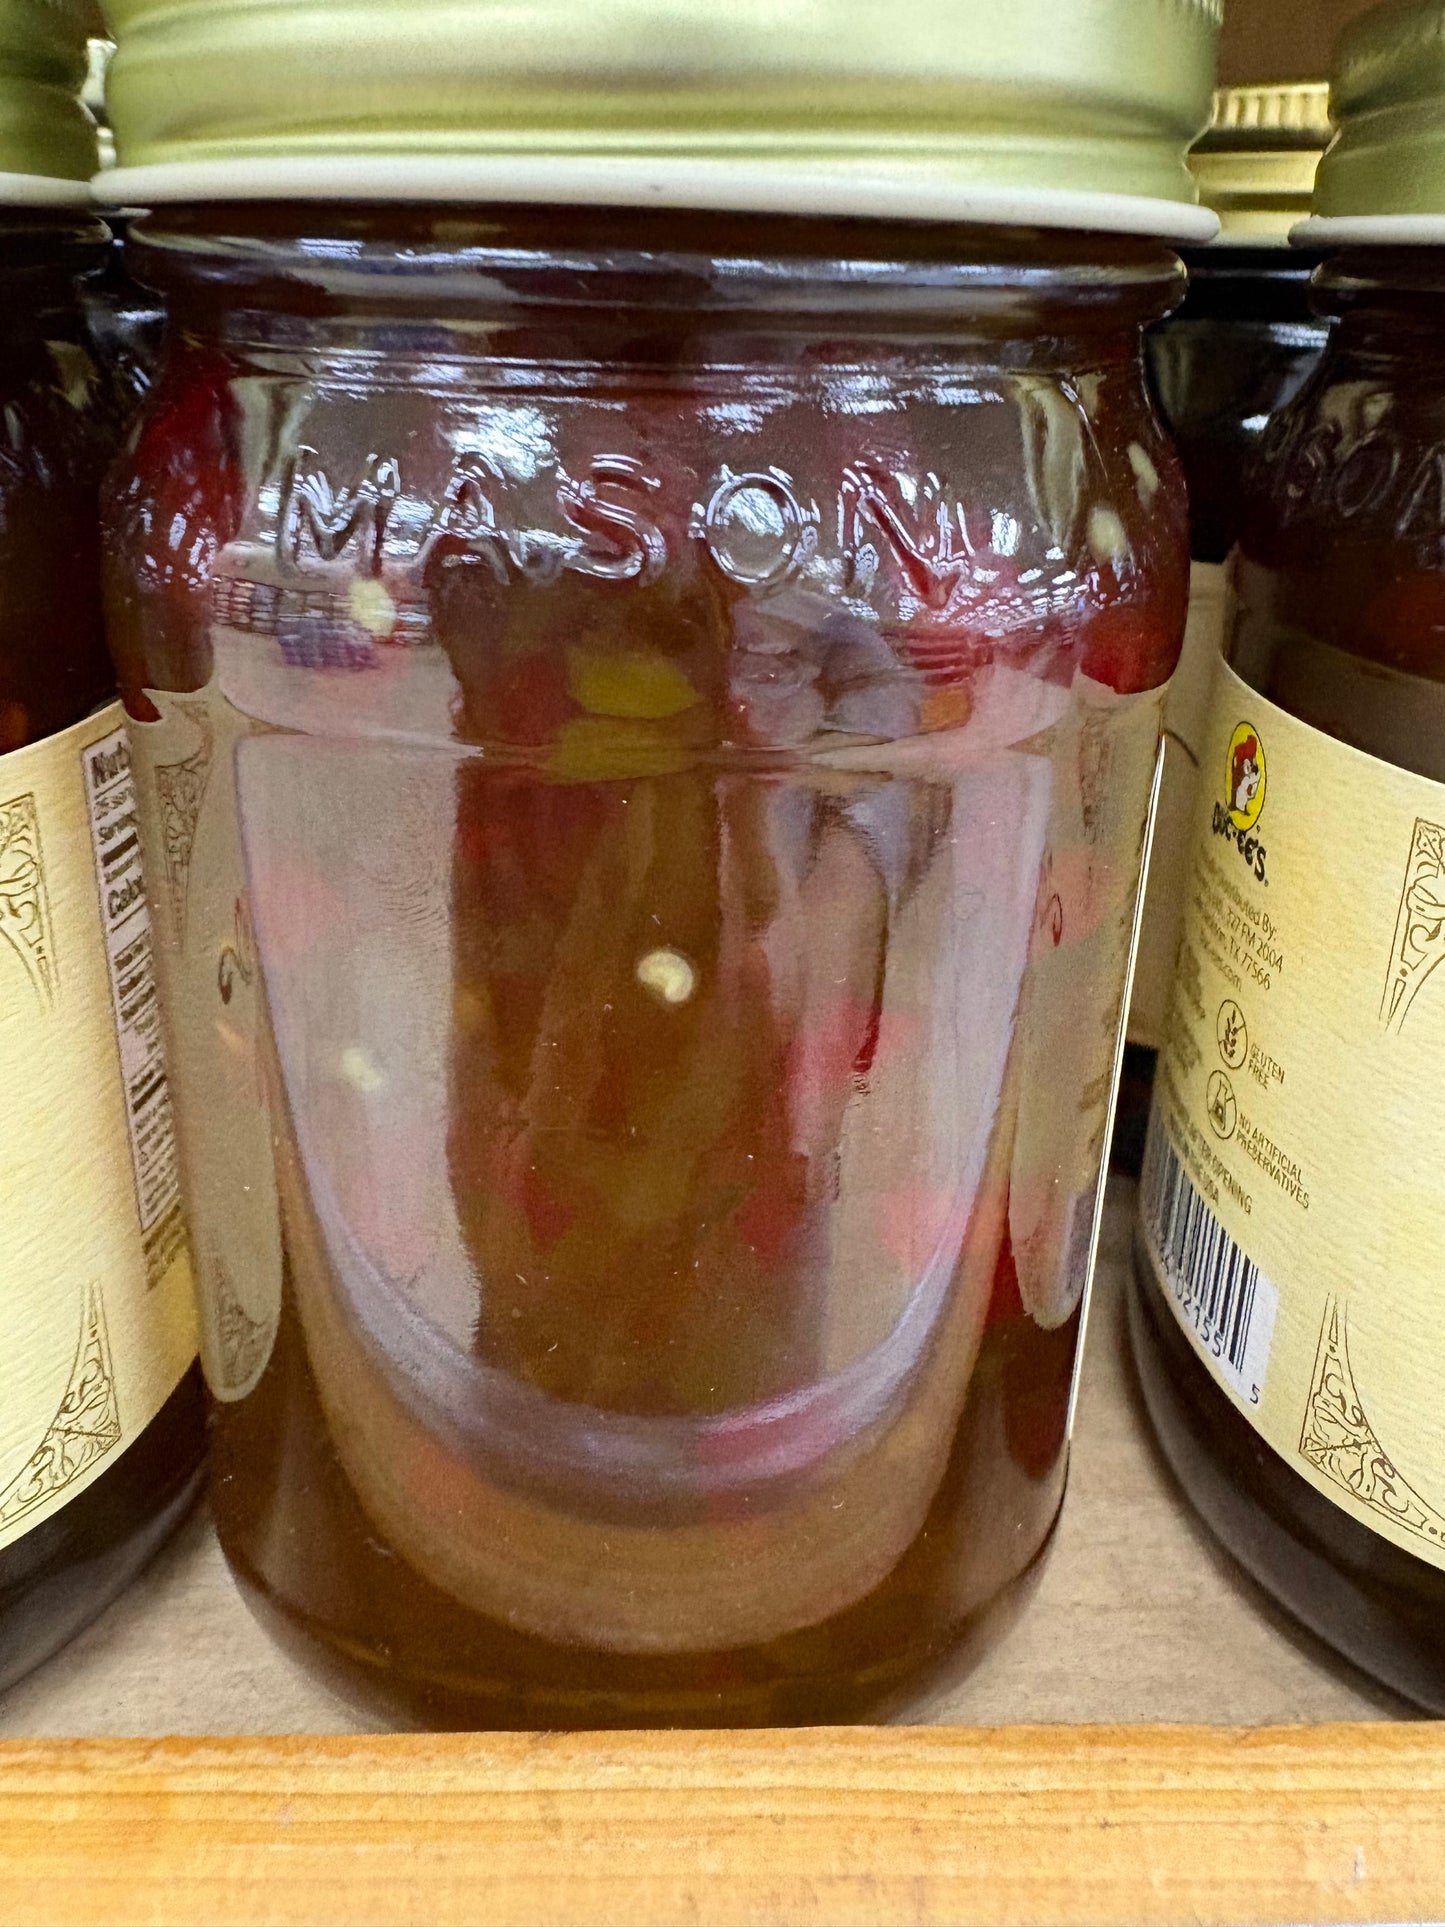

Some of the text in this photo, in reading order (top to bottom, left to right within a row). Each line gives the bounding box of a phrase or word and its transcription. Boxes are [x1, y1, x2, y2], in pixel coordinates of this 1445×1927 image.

[274, 445, 975, 607] MASON
[1256, 937, 1284, 974] 2004
[1249, 1059, 1269, 1090] FREE
[1250, 1042, 1285, 1085] GLUTEN
[1237, 1129, 1310, 1210] PRESERVATIVES
[1239, 1112, 1250, 1135] NO
[1251, 1127, 1304, 1185] ARTIFICIAL
